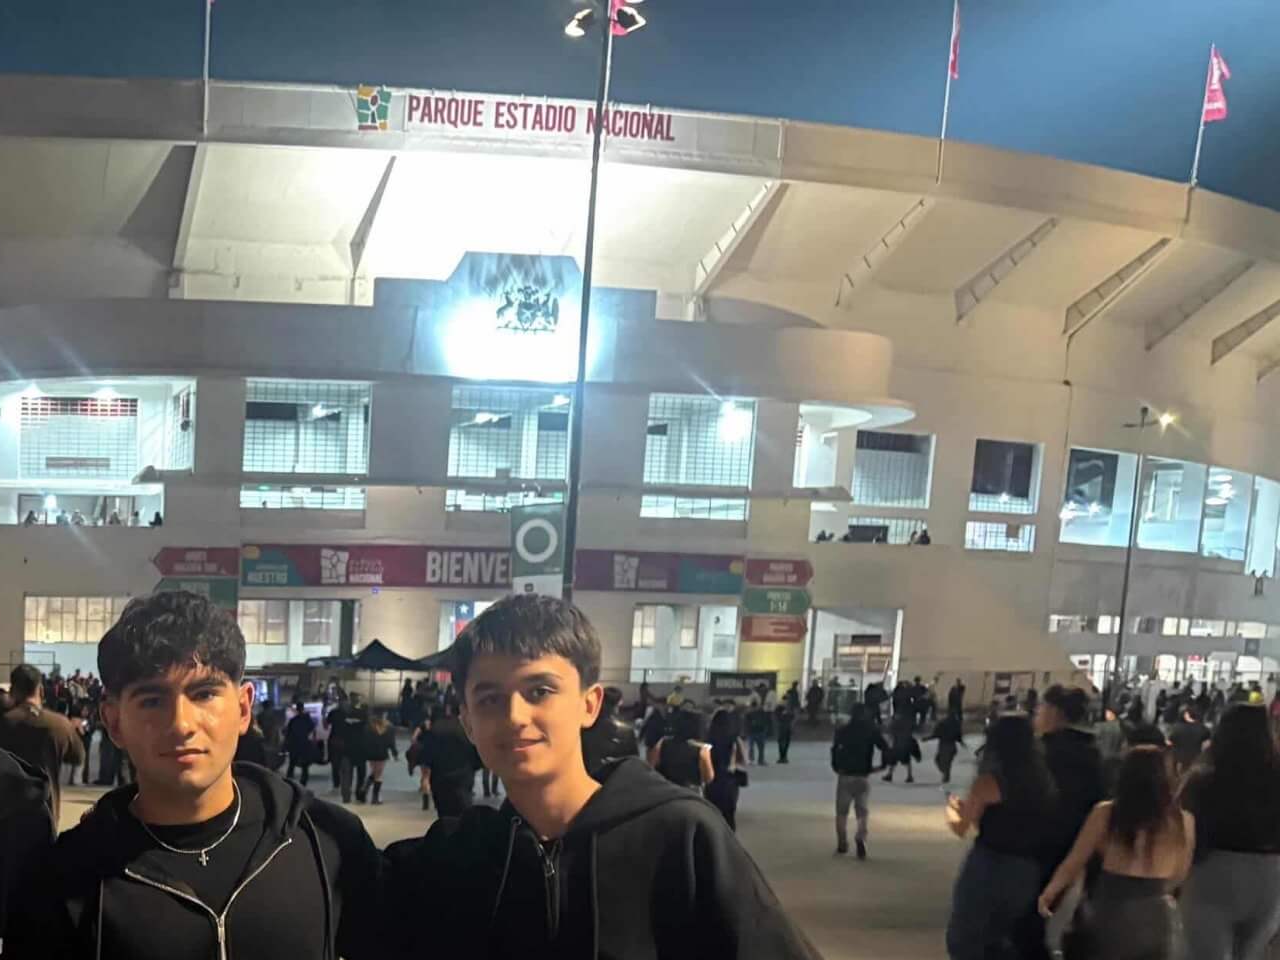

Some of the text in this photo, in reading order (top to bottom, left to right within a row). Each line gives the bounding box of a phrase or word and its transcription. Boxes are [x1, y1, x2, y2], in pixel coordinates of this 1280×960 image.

[407, 94, 676, 142] PARQUE ESTADIO NACIONAL
